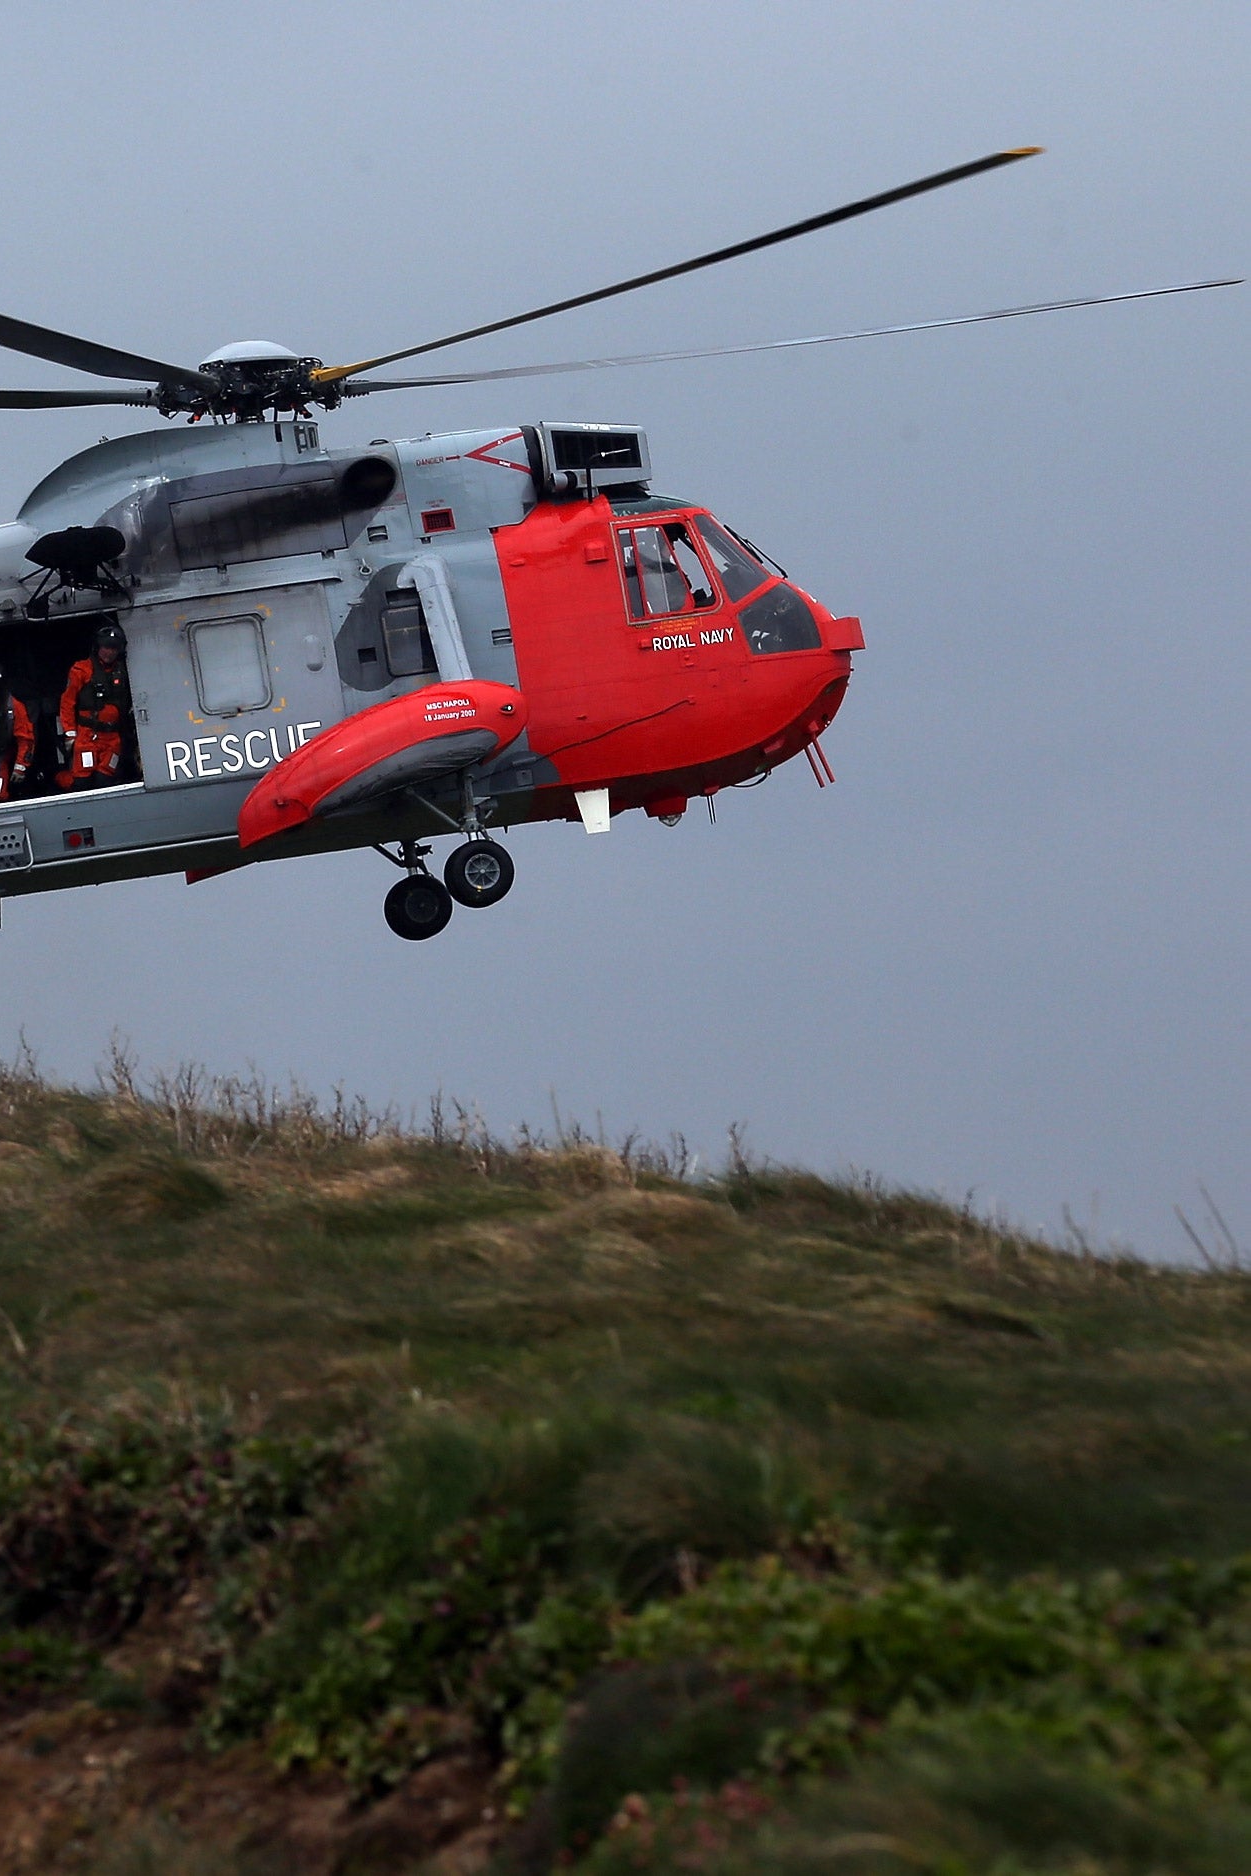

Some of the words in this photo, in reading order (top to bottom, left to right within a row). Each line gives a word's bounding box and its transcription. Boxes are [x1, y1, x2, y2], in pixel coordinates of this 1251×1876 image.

[415, 456, 444, 467] DANGER
[652, 633, 696, 652] ROYAL
[699, 627, 734, 645] NAVY
[426, 702, 442, 710] MSC
[443, 699, 470, 708] NAPOLI
[433, 711, 460, 720] January
[460, 709, 476, 718] 2007
